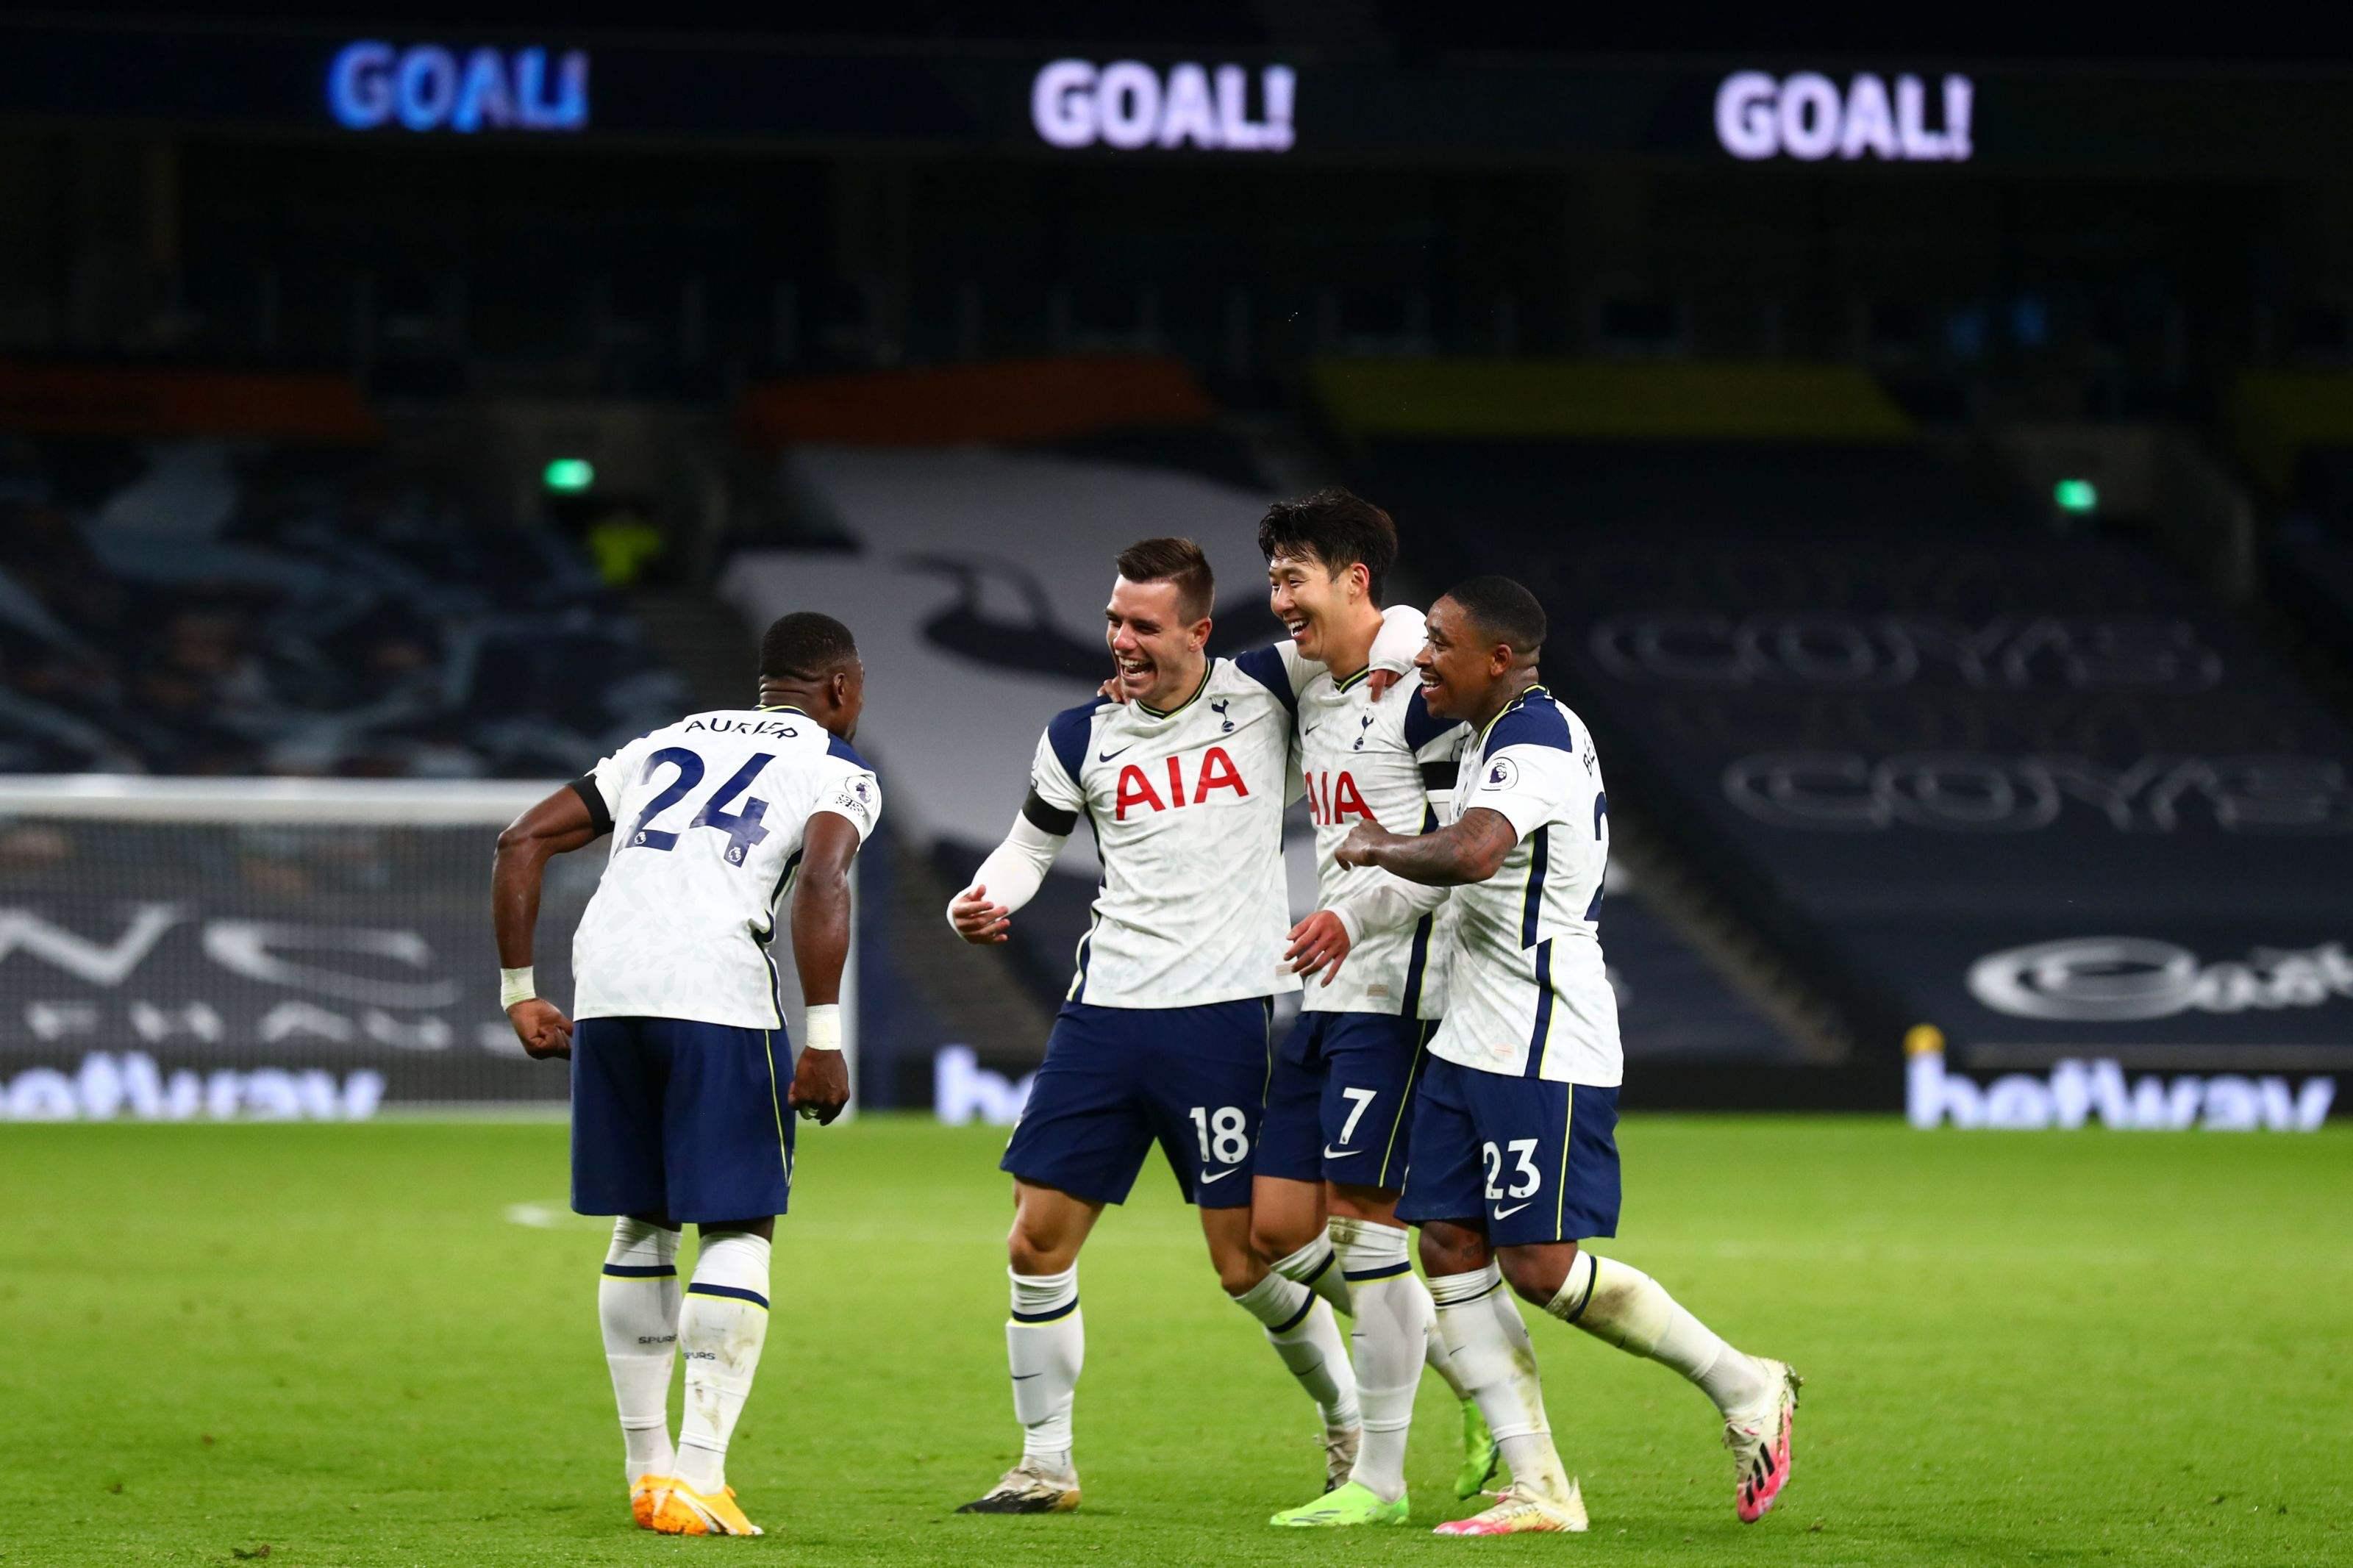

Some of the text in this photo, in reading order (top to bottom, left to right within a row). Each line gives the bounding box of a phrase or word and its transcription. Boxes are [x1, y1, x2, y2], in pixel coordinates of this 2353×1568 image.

[1032, 59, 1296, 151] GOAL!
[1715, 70, 1973, 162] GOAL!
[685, 717, 799, 740] AURIER
[613, 746, 777, 868] 24
[1116, 747, 1250, 821] AIA
[1189, 1106, 1249, 1164] 18
[1338, 1087, 1377, 1145] 7
[1482, 1139, 1541, 1200] 23
